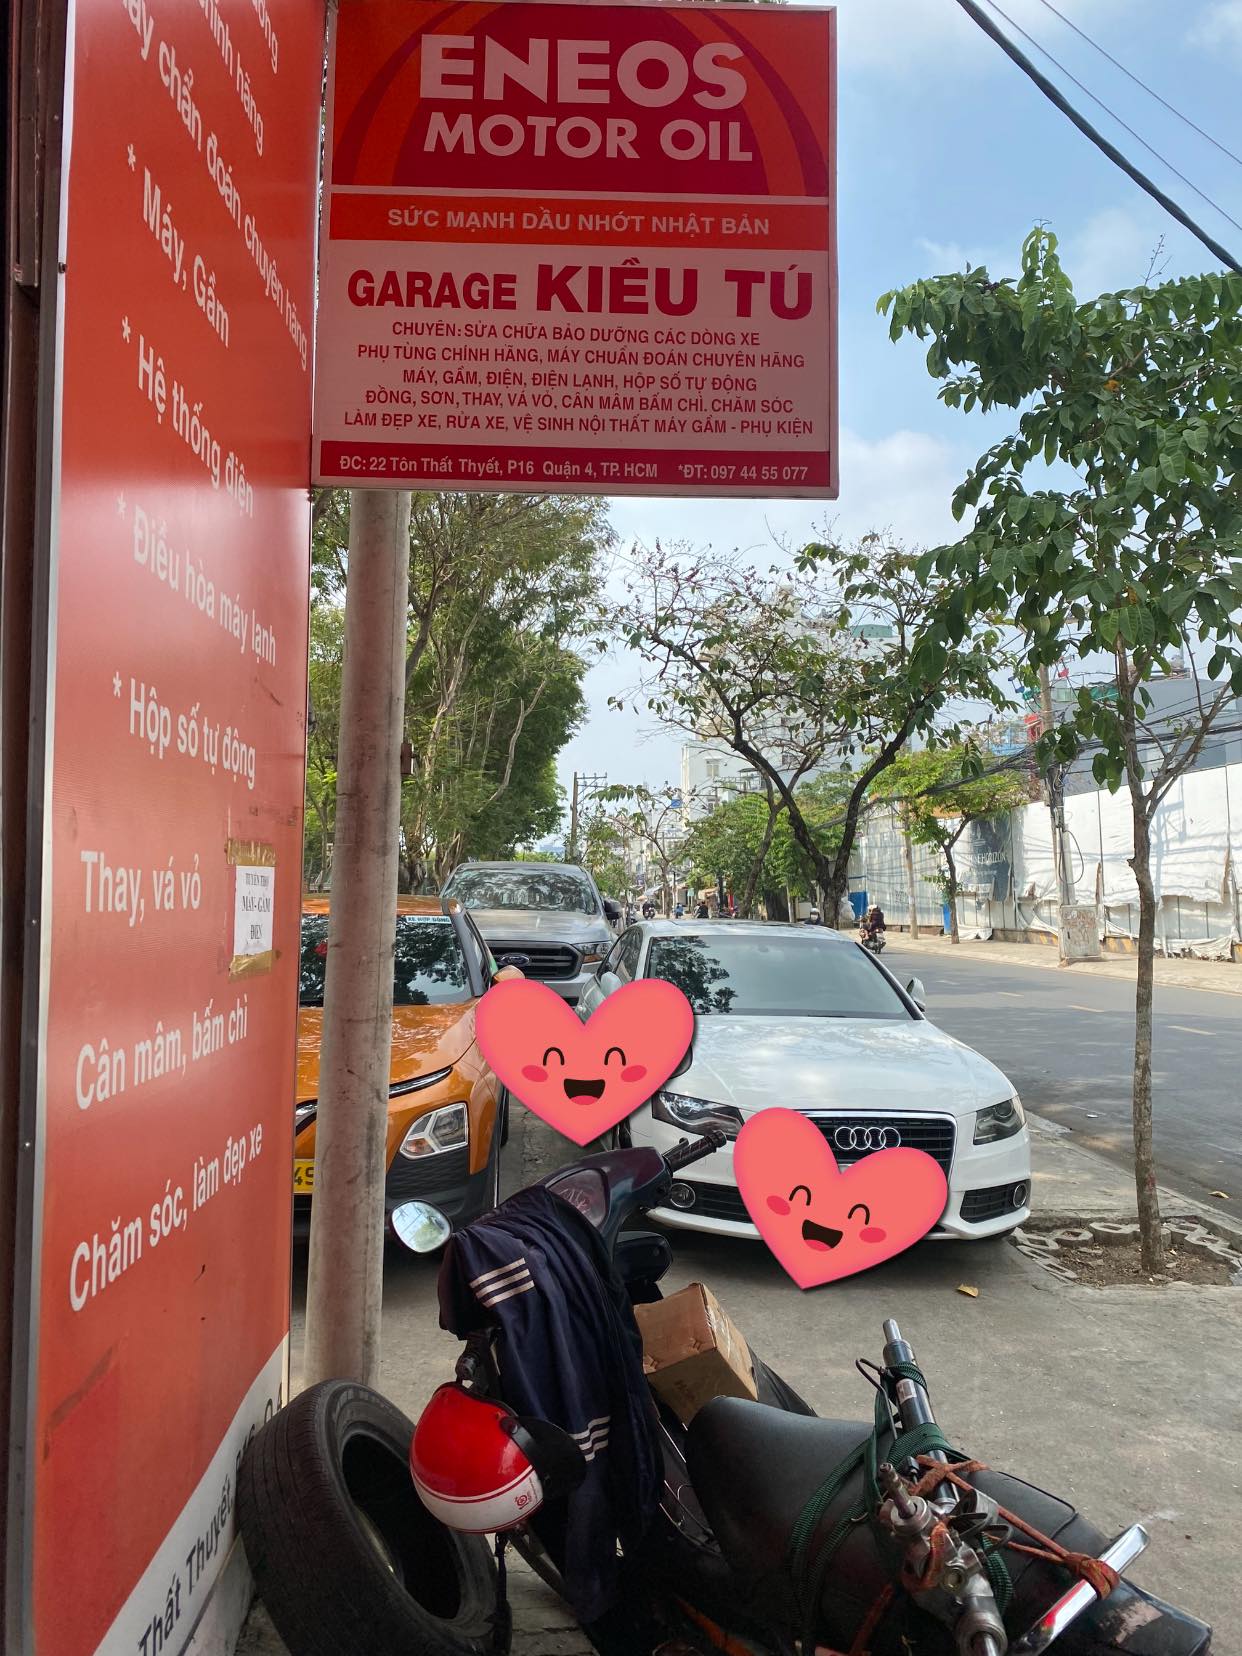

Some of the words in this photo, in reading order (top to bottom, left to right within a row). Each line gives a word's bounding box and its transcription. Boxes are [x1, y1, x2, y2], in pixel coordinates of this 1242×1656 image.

[420, 33, 747, 110] ENEOS
[424, 111, 640, 159] MOTOR
[659, 118, 753, 162] OIL
[143, 166, 186, 291] Máy,
[388, 204, 439, 227] SỨC
[446, 210, 515, 233] MẠNH
[522, 206, 570, 231] DẦU
[578, 210, 645, 232] NHỚT
[651, 212, 715, 238] NHẬT
[720, 211, 769, 235] BẢN
[245, 214, 284, 315] chuyên
[348, 269, 517, 310] GARAGE
[536, 258, 698, 316] KIỀU
[725, 263, 813, 320] TÚ
[358, 344, 389, 363] PHỤ
[393, 341, 436, 360] TÙNG
[441, 345, 490, 362] CHÍNH
[547, 346, 580, 363] MÁY
[643, 348, 687, 366] ĐOÁN
[692, 350, 755, 367] CHUYÊN
[760, 351, 805, 368] HÃNG
[392, 320, 462, 337] CHUYÊN:
[464, 320, 498, 338] SỬA
[502, 322, 548, 340] CHỮA
[553, 322, 585, 341] BẢO
[590, 325, 649, 343] DƯỠNG
[654, 328, 686, 345] CÁC
[691, 328, 736, 345] DÒNG
[741, 332, 760, 346] XE
[366, 384, 416, 407] ĐỒNG,
[421, 390, 460, 407] SƠN,
[462, 391, 503, 407] THAY,
[508, 390, 528, 407] VÁ
[562, 393, 594, 409] CÂN
[599, 393, 634, 411] MÂM
[639, 392, 673, 411] BẤM
[711, 396, 756, 413] CHĂM
[761, 396, 793, 413] SÓC
[403, 367, 438, 385] MÁY,
[443, 366, 482, 387] GẦM,
[486, 368, 527, 390] ĐIỆN,
[532, 370, 568, 390] ĐIỆN
[573, 374, 618, 392] LẠNH,
[623, 372, 655, 393] HỘP
[660, 371, 682, 390] SỐ
[685, 376, 707, 394] TỰ
[711, 374, 757, 394] ĐỘNG
[138, 334, 167, 424] Hệ
[172, 381, 221, 489] thống
[225, 452, 254, 518] điện
[344, 409, 377, 426] LÀM
[382, 413, 413, 430] ĐẸP
[417, 415, 441, 430] XE,
[446, 411, 480, 429] RỬA
[485, 416, 509, 432] XE,
[513, 413, 532, 433] VỆ
[537, 416, 574, 431] SINH
[579, 415, 606, 435] NỘI
[609, 414, 649, 433] THẤT
[654, 416, 687, 433] MÁY
[741, 420, 772, 438] PHỤ
[777, 417, 813, 438] KIỆN
[340, 455, 366, 470] ĐC:
[370, 456, 387, 471] 22
[390, 457, 417, 472] Tôn
[421, 455, 453, 473] Thất
[507, 459, 534, 475] P16
[543, 461, 580, 479] Quận
[585, 462, 597, 479] 4,
[600, 462, 621, 477] TP.
[624, 463, 658, 478] HCM
[710, 464, 736, 480] 097
[740, 465, 757, 480] 44
[761, 466, 778, 481] 55
[782, 466, 808, 481] 077
[133, 504, 180, 592] Điều
[185, 549, 215, 619] hòa
[220, 594, 248, 654] máy
[251, 609, 276, 667] lạnh
[129, 677, 171, 760] Hộp
[177, 702, 200, 758] số
[203, 716, 220, 775] tự
[222, 726, 255, 790] động
[80, 850, 145, 927] Thay,
[152, 855, 174, 910] vá
[180, 853, 201, 909] vỏ
[76, 1037, 125, 1110] Cân
[134, 1020, 187, 1086] mâm,
[192, 998, 224, 1061] bấm
[228, 993, 248, 1044] chì
[70, 1215, 142, 1312] Chăm
[149, 1178, 187, 1247] sóc,
[193, 1156, 219, 1212] làm
[223, 1135, 246, 1186] đẹp
[249, 1123, 262, 1162] xe
